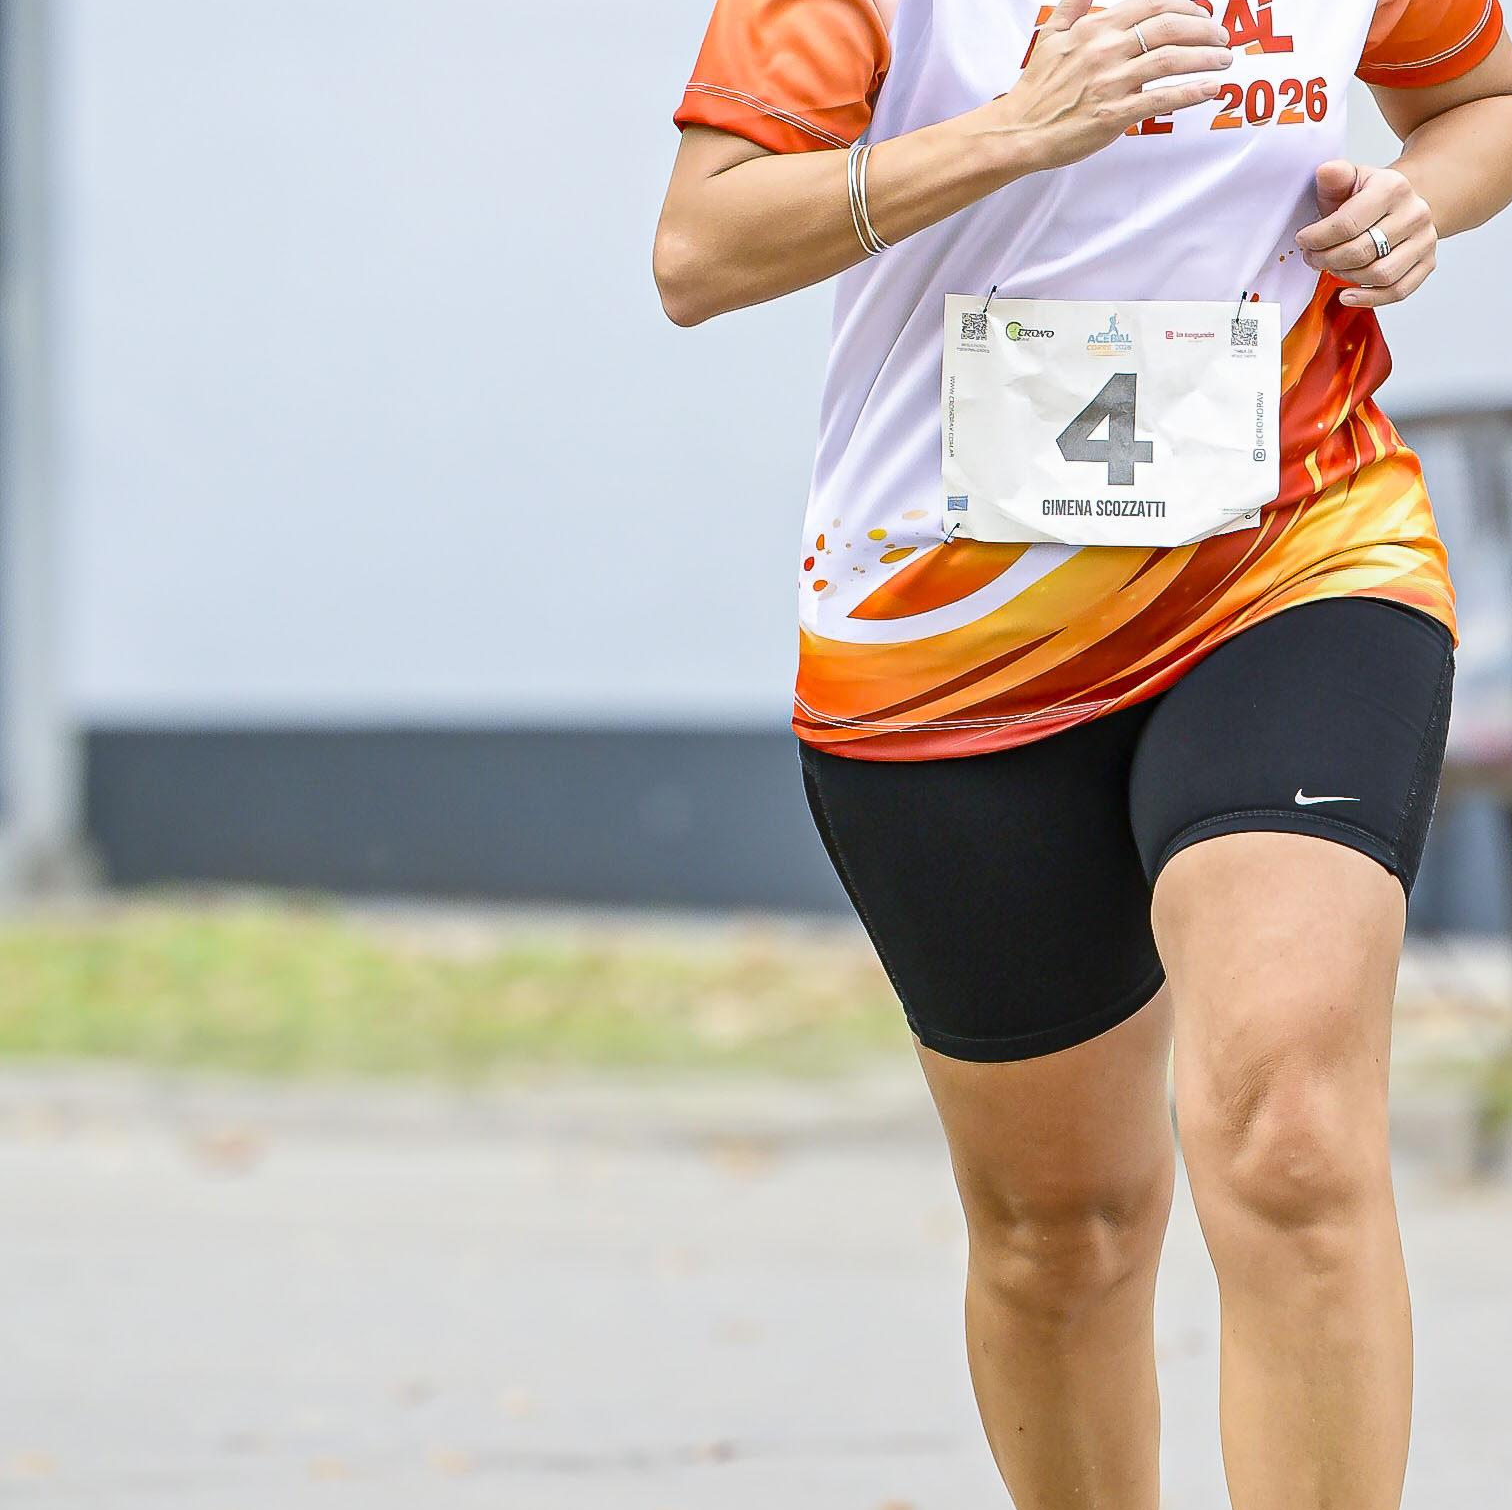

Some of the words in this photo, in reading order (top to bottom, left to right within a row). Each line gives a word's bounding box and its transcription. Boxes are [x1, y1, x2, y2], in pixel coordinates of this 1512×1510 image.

[1210, 76, 1328, 130] 2026
[1087, 332, 1133, 344] ACEBAL
[1056, 372, 1153, 486] 4
[1255, 391, 1264, 447] @CRONORAV
[1042, 499, 1093, 516] GIMENA
[1096, 499, 1166, 517] SCOZZATTI
